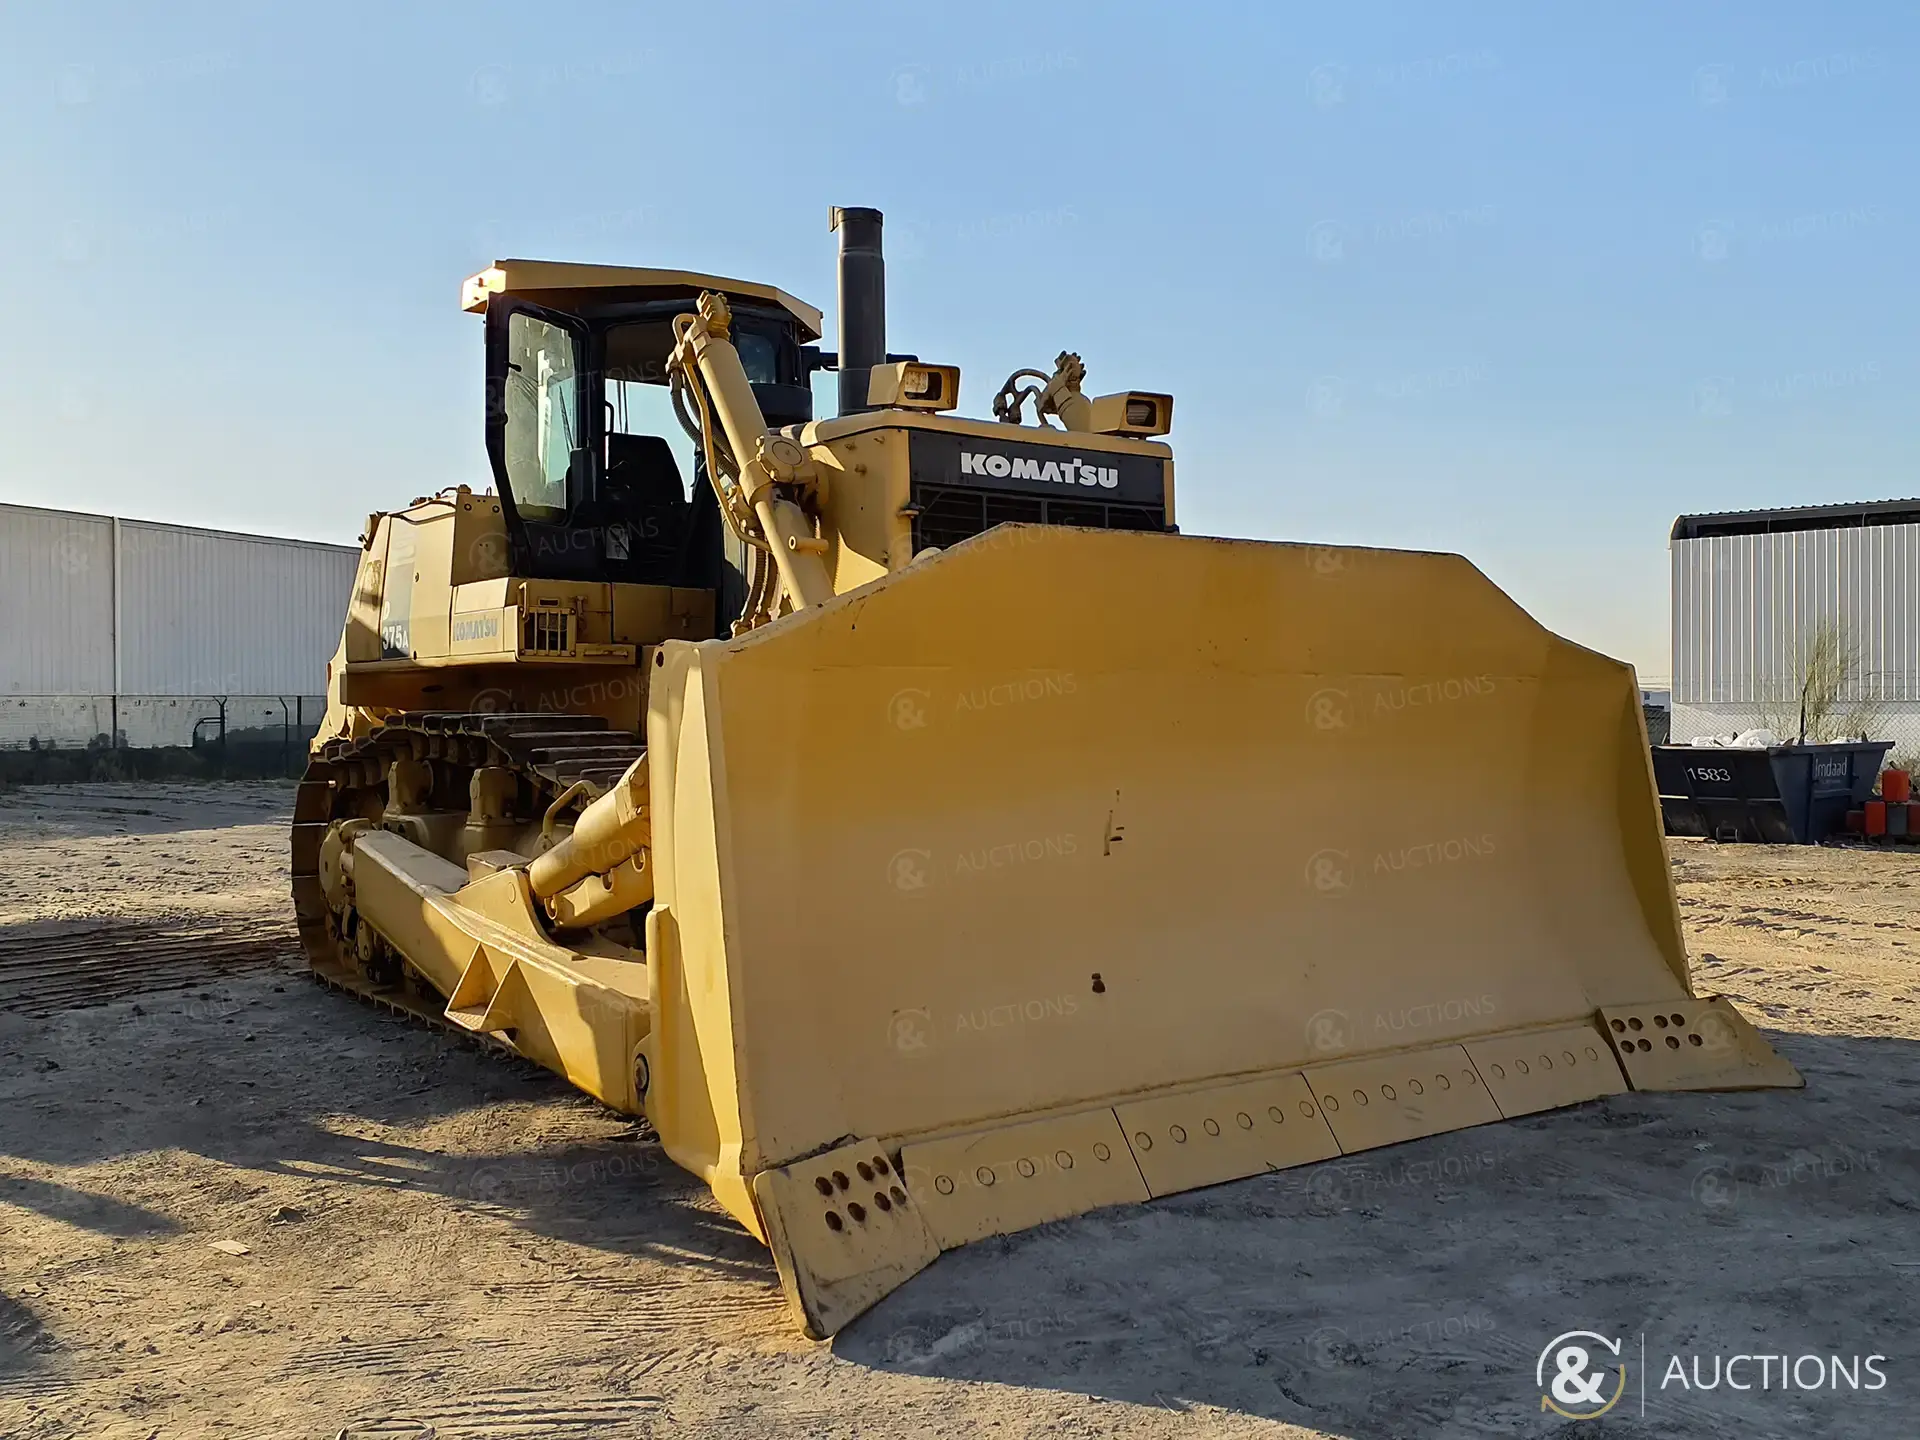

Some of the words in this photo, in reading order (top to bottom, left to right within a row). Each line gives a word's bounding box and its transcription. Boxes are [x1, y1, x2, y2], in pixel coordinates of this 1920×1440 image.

[960, 452, 1119, 489] KOMATSU
[382, 624, 409, 650] 375A
[1687, 767, 1731, 782] 1583
